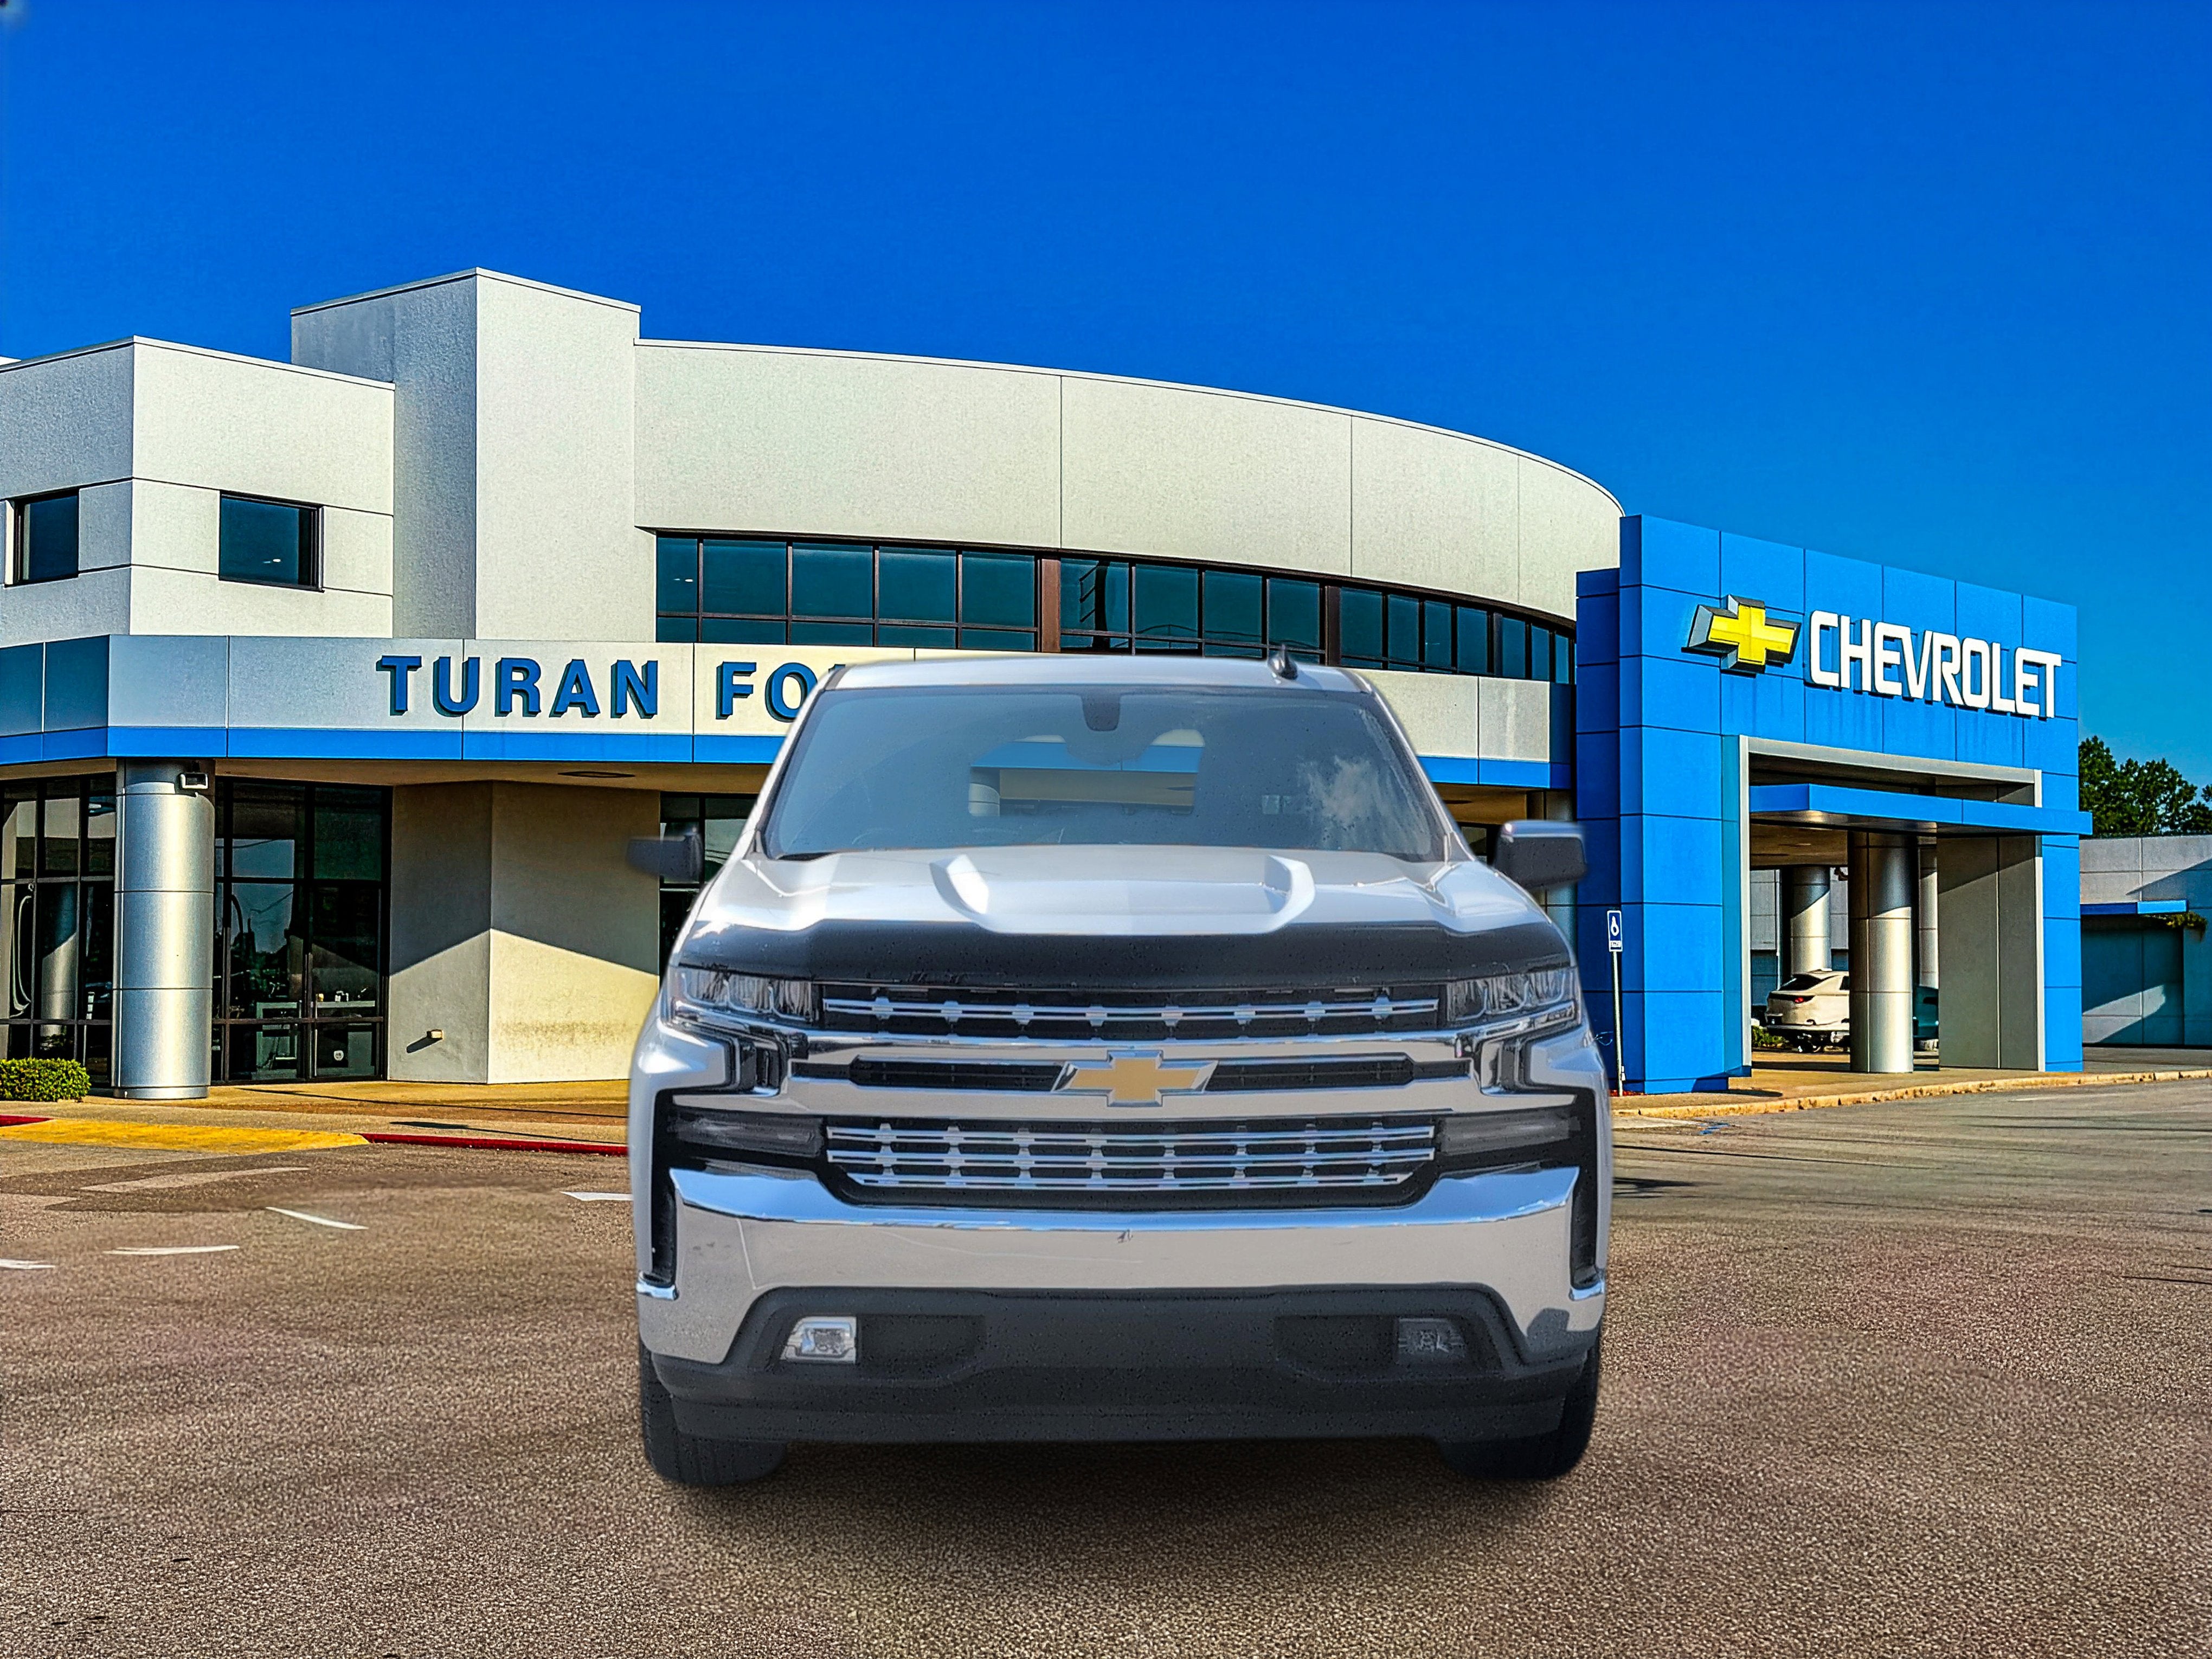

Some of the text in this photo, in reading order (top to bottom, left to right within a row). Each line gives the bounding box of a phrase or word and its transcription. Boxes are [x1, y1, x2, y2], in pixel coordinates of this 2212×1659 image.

[376, 655, 846, 723] TURAN FO
[1808, 610, 2062, 718] CHEVROLET
